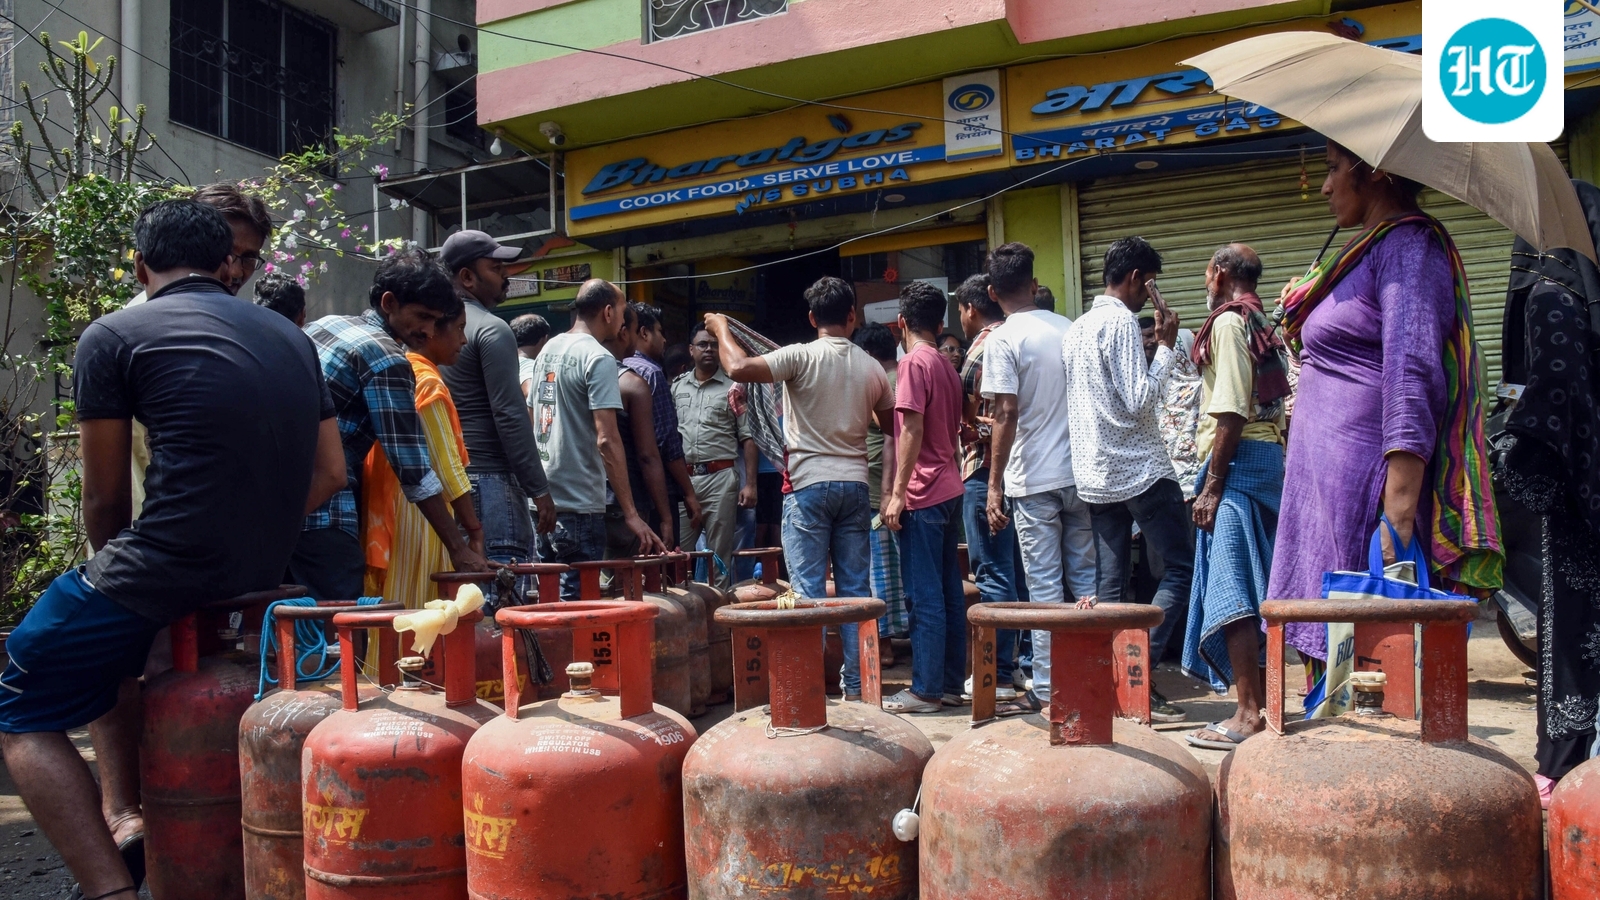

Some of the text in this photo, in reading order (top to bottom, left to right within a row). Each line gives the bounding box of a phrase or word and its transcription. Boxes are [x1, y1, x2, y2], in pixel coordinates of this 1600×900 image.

[1030, 69, 1214, 115] भार
[955, 115, 990, 125] भारत
[955, 130, 992, 141] लियम
[1015, 116, 1281, 161] BHARAT GAS
[581, 122, 923, 195] Bharatgas
[619, 190, 681, 209] COOK
[763, 163, 840, 185] SERVE
[848, 151, 920, 171] LOVE.
[792, 168, 910, 196] SUBHA
[593, 631, 612, 667] 15.5
[746, 637, 761, 685] 15.6
[363, 730, 387, 738] WHEN
[537, 740, 590, 748] REGULATOR
[655, 731, 684, 746] 1906
[525, 746, 550, 755] WHEN
[571, 746, 580, 754] IN
